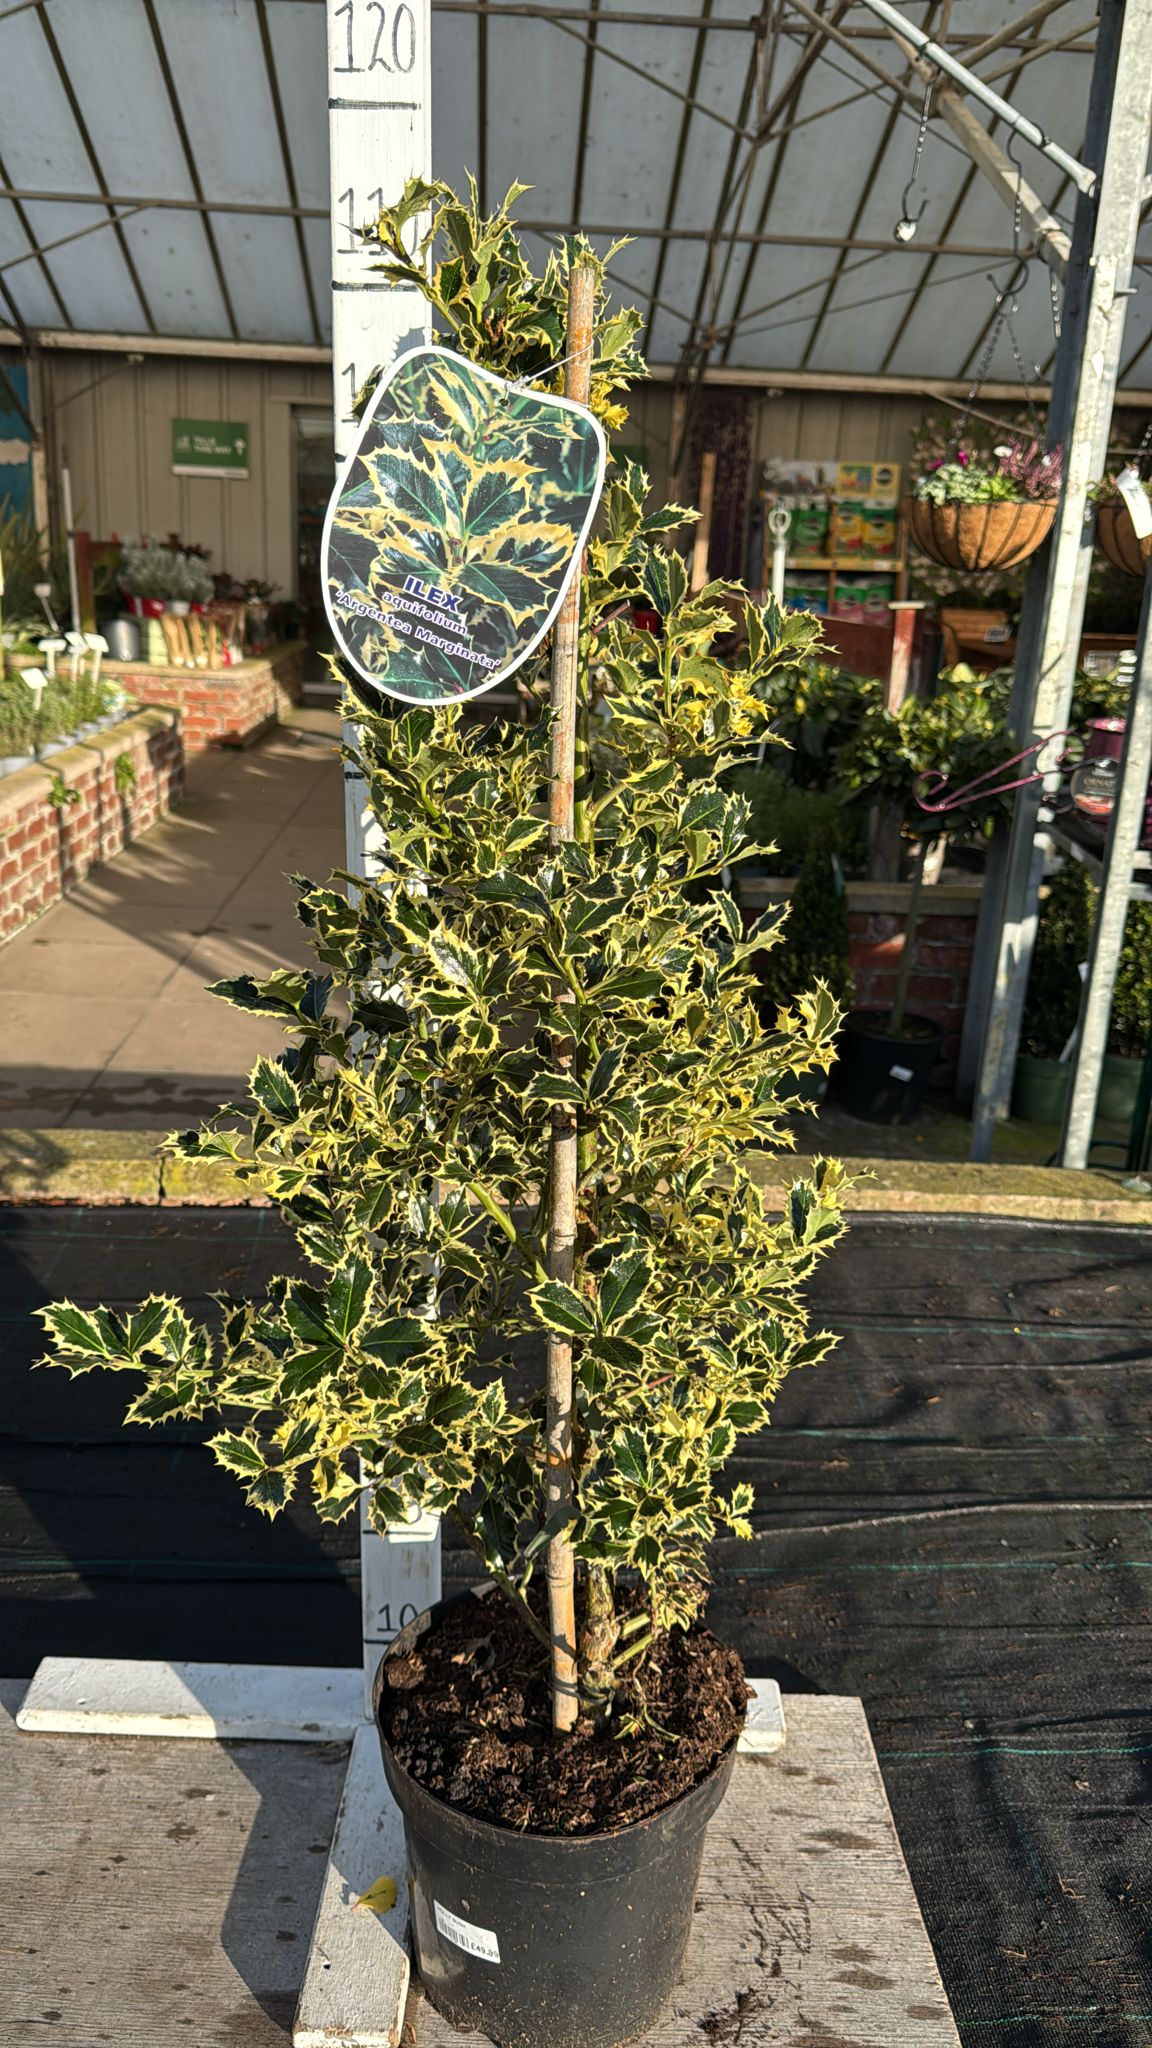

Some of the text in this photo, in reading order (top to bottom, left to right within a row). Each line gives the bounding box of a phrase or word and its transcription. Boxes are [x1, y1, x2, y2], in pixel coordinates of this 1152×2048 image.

[334, 0, 416, 73] 120
[337, 187, 418, 256] 11
[382, 592, 468, 636] aquifolium
[403, 575, 463, 613] ILEX
